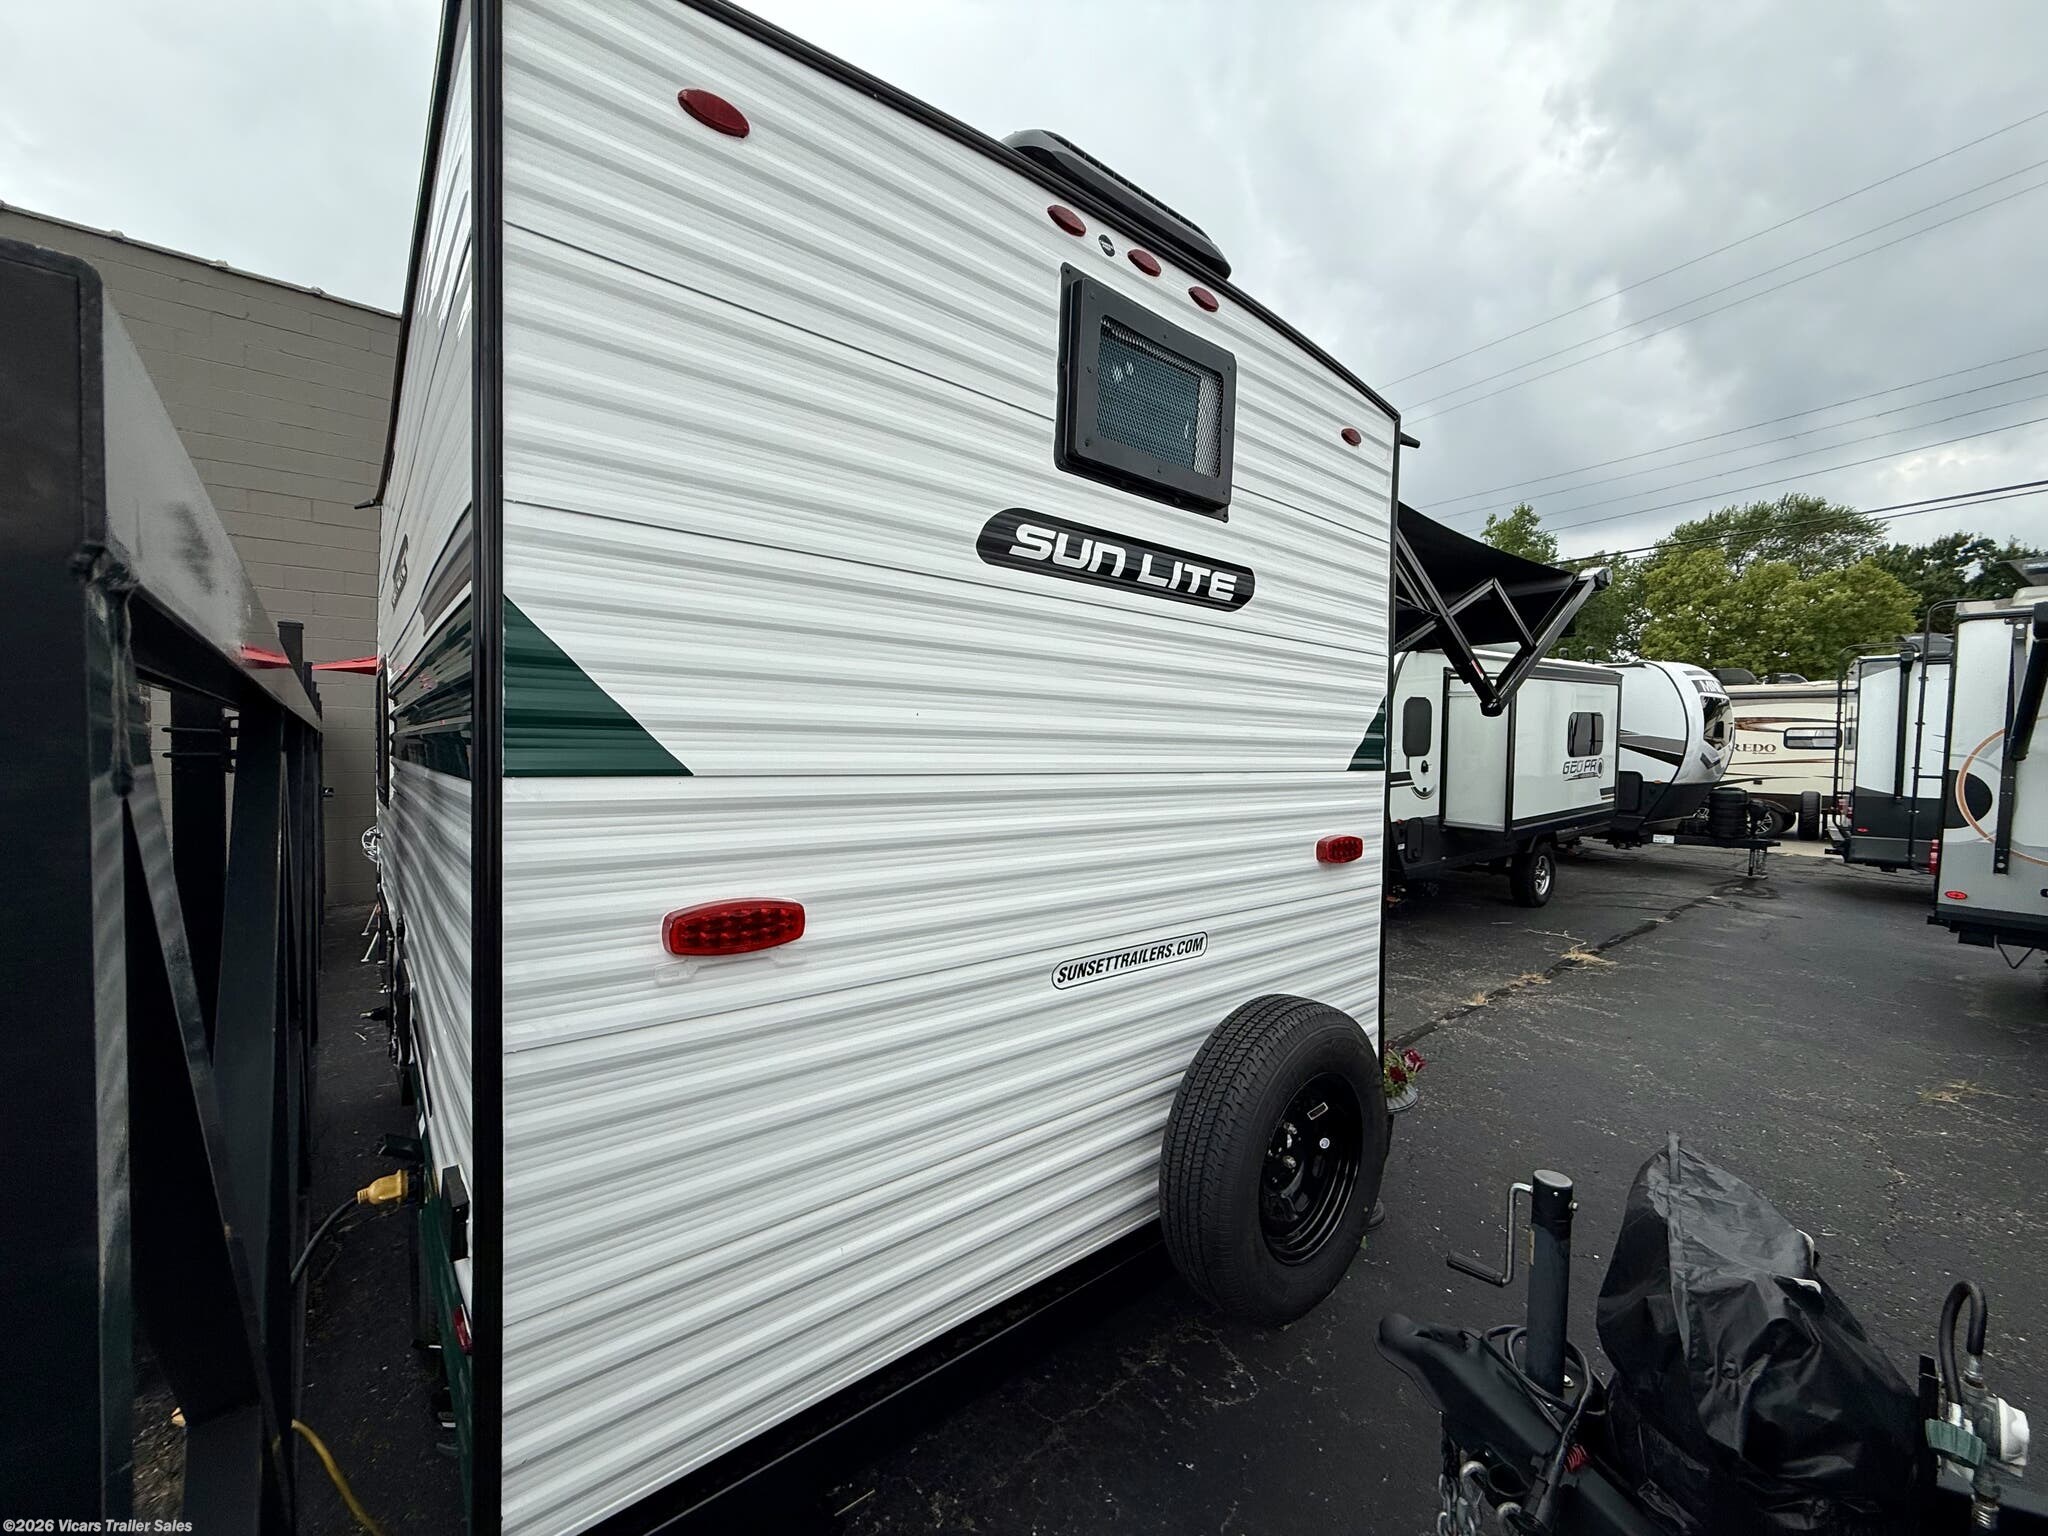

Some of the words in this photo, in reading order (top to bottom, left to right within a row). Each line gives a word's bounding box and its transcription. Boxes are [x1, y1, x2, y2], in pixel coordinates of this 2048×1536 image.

[1009, 523, 1126, 577] SUN
[1137, 553, 1237, 601] LITE
[1057, 937, 1204, 983] SUNSETTRAILERS.COM
